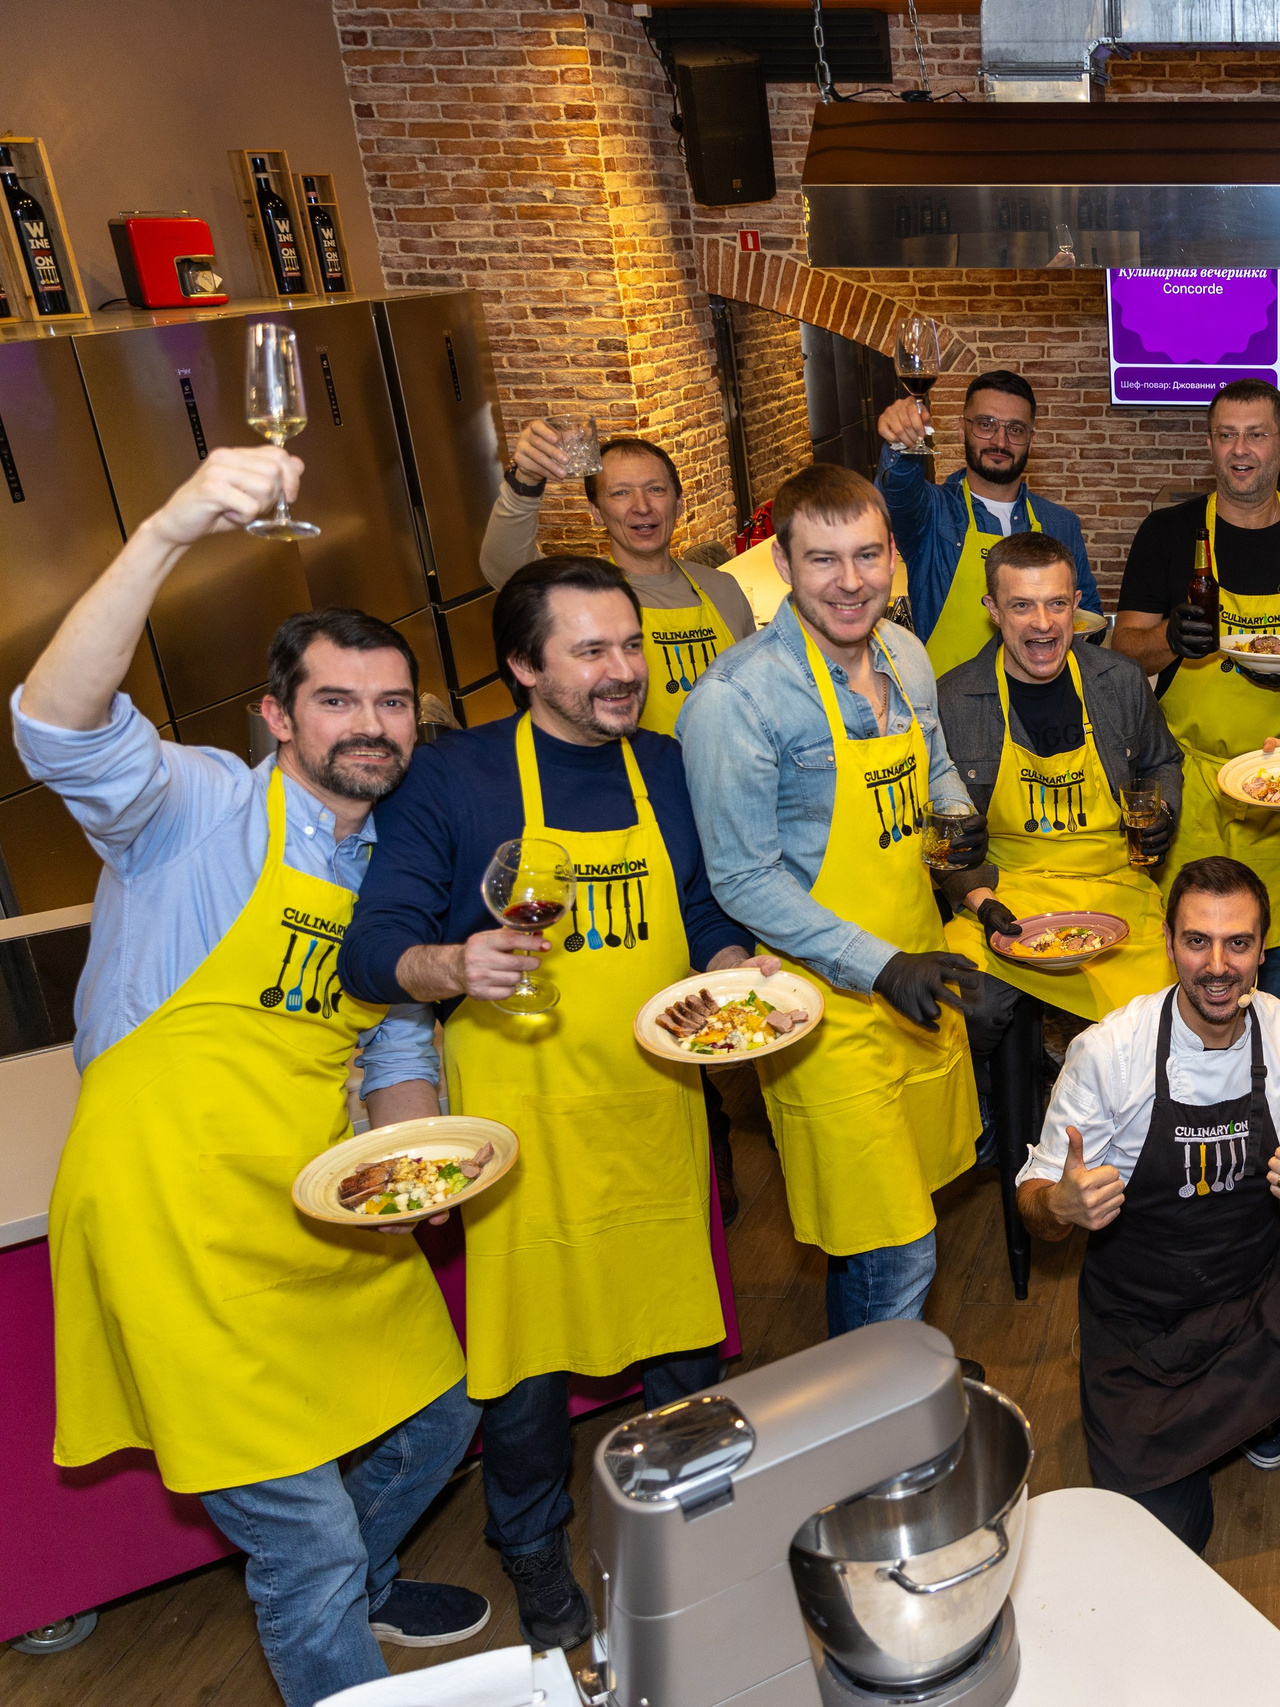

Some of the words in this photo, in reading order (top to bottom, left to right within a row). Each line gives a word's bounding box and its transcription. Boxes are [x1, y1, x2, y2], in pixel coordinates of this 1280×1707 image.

[281, 247, 296, 256] ON
[326, 251, 338, 260] ON
[34, 255, 54, 267] ON
[1118, 268, 1198, 280] Кулинарная
[1200, 268, 1267, 280] вечеринка
[1163, 282, 1224, 294] Concorde
[1120, 381, 1171, 390] Шеф-повар:
[1172, 381, 1216, 390] Джованни
[283, 907, 346, 937] CULINAR
